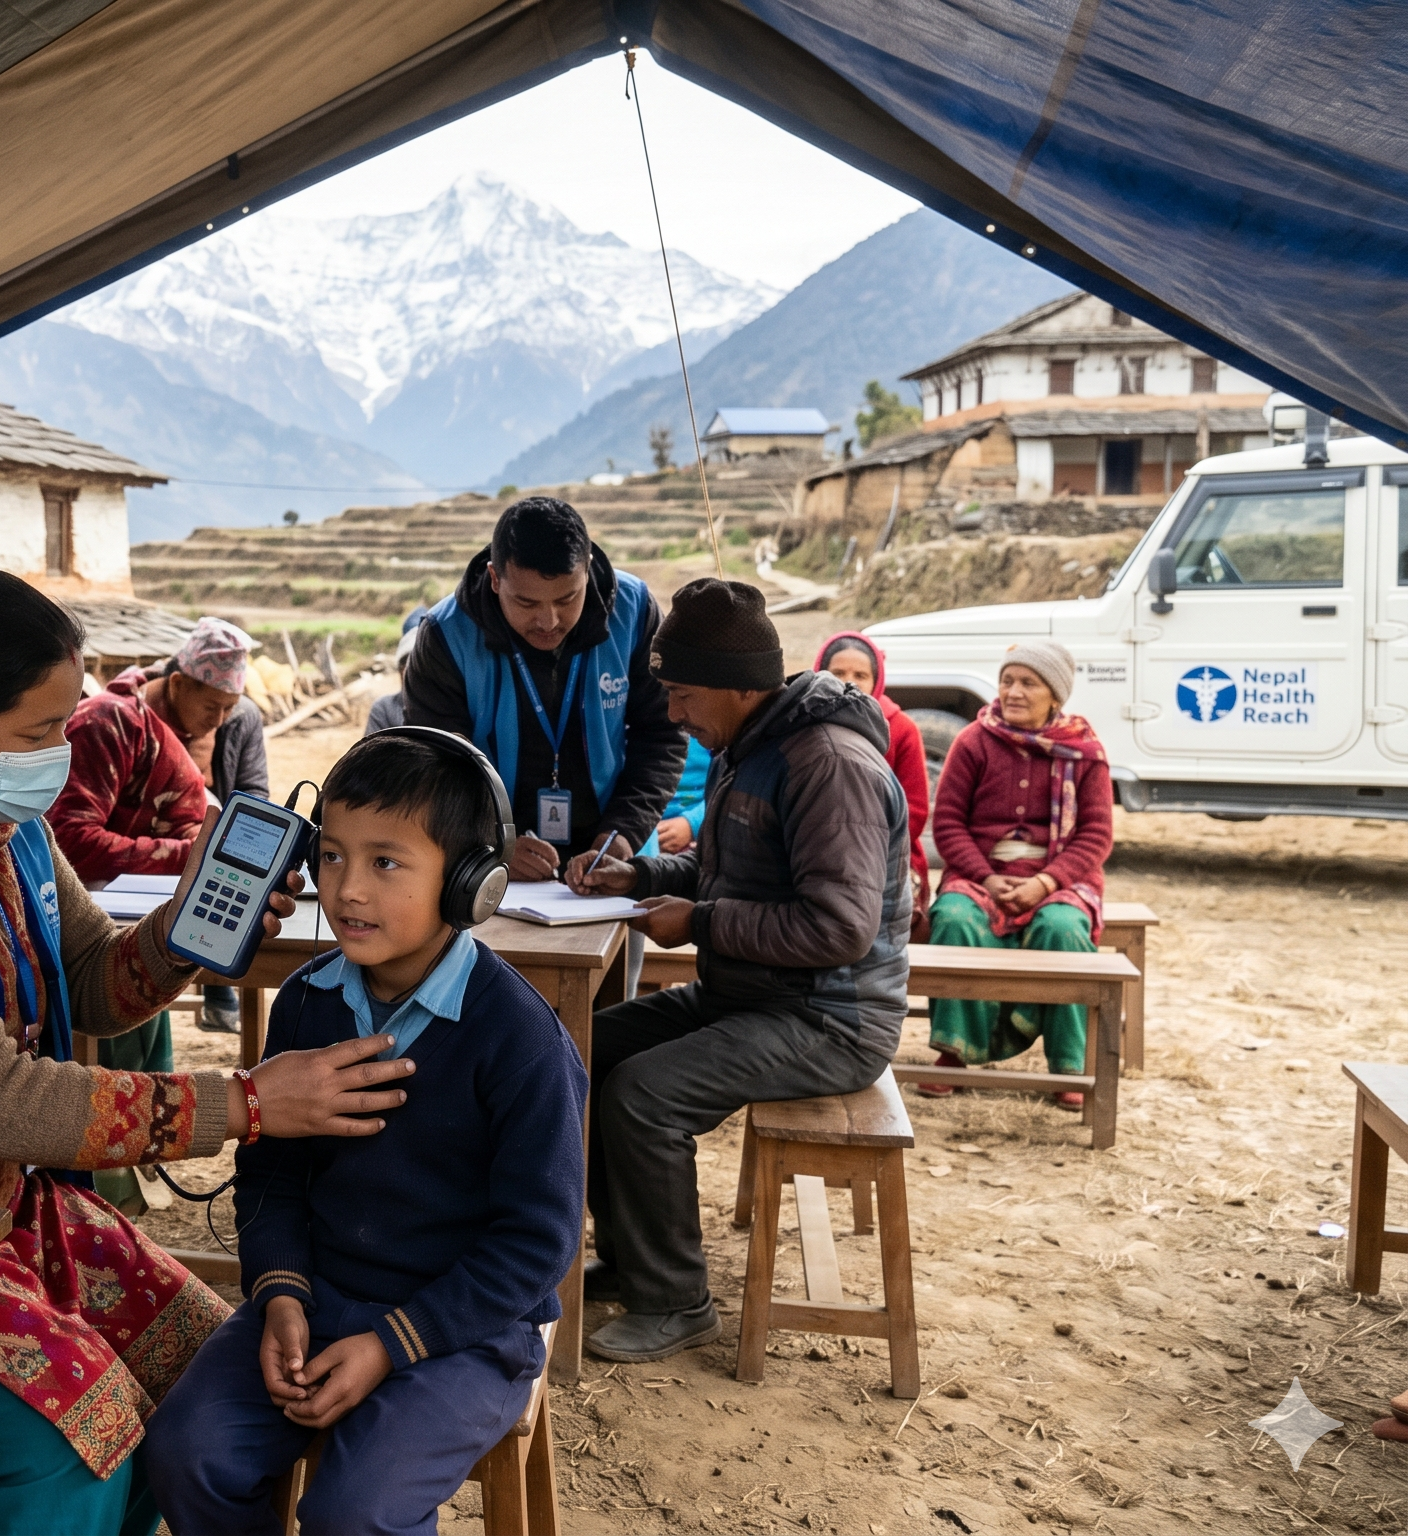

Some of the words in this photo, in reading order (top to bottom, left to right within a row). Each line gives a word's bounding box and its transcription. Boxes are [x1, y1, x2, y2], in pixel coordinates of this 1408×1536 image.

[1243, 667, 1306, 687] Nepal
[1242, 688, 1316, 705] Health
[1242, 707, 1309, 725] Reach
